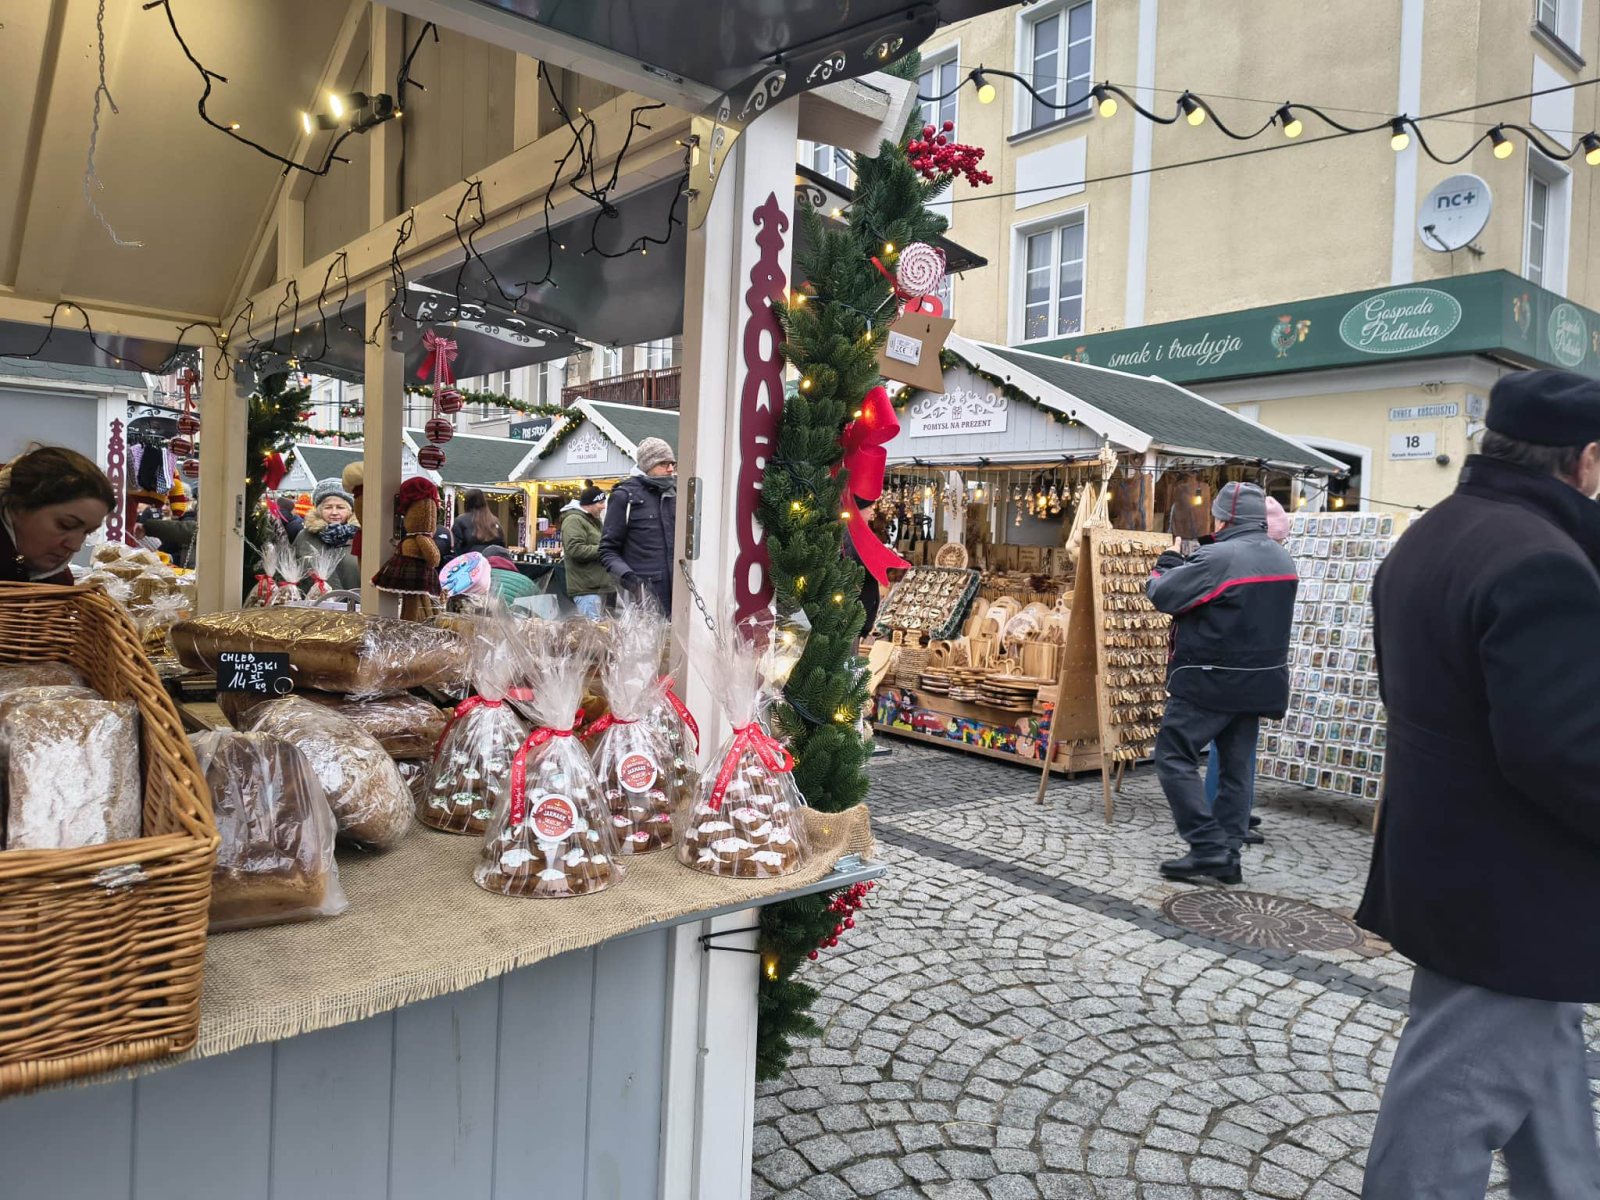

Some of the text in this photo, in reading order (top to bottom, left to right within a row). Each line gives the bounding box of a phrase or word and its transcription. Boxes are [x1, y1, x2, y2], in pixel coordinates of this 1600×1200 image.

[1437, 191, 1476, 209] nc+
[1364, 296, 1435, 323] Gospoda
[1359, 319, 1442, 346] Podlaska
[1108, 332, 1243, 368] smak i tradycja
[950, 421, 960, 429] NA
[961, 419, 992, 428] PREZENT
[1405, 435, 1420, 448] 18
[220, 652, 256, 663] CHLEB
[228, 671, 246, 689] 14
